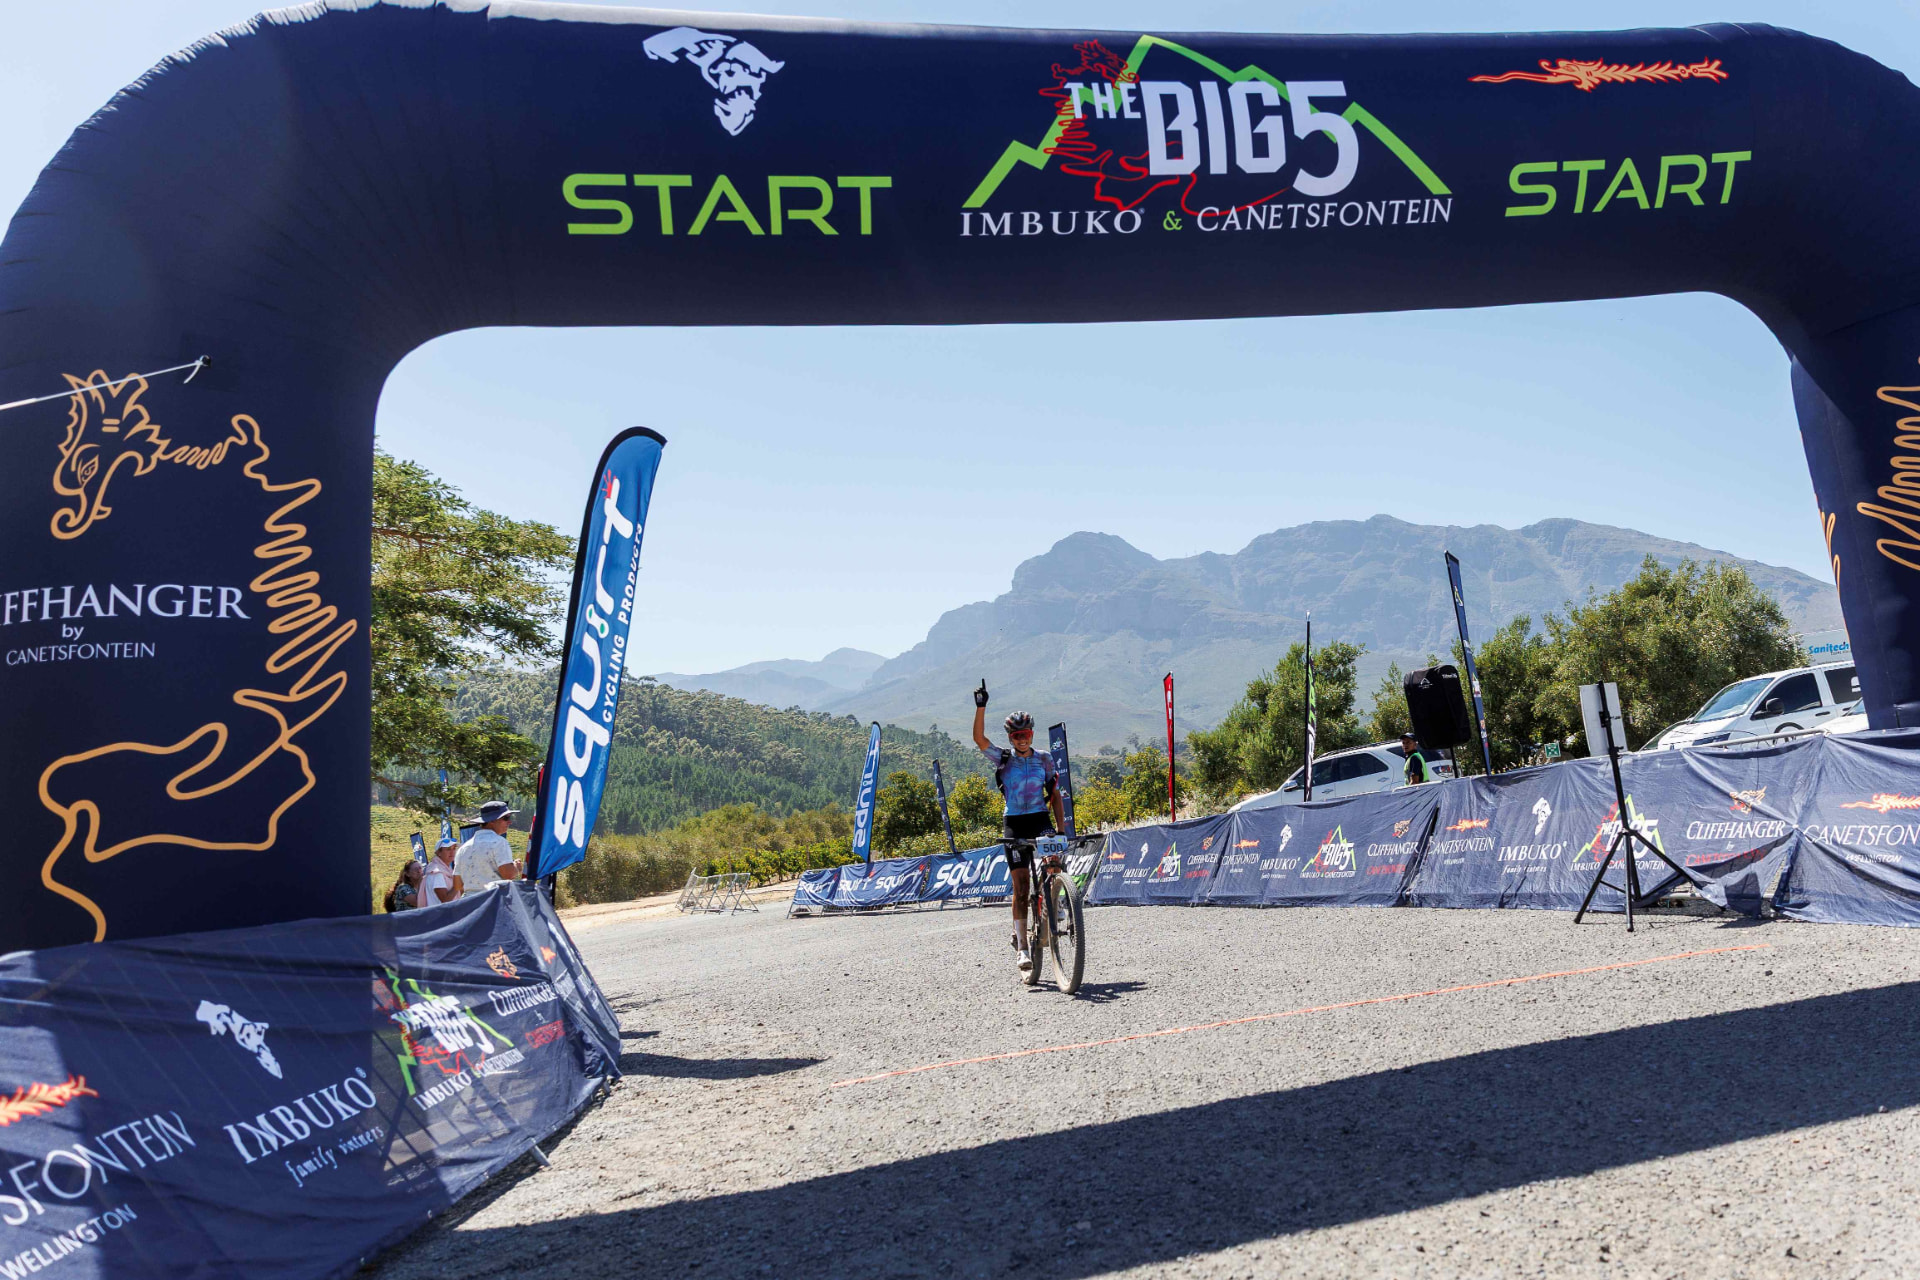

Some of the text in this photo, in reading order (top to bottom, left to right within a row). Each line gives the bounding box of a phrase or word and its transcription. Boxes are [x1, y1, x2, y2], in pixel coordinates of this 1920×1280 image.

[1064, 81, 1142, 119] THE
[1504, 150, 1752, 218] START
[562, 173, 893, 235] START
[1163, 209, 1183, 232] &
[1197, 197, 1453, 233] CANETSFONTEIN
[0, 584, 252, 627] FFHANGER
[62, 624, 84, 641] by
[1808, 641, 1850, 655] Sanitech
[6, 642, 156, 666] CANETSFONTEIN
[553, 477, 634, 849] squirt
[602, 633, 626, 723] CYCLING
[1043, 843, 1063, 853] 500
[1367, 842, 1419, 857] CLIFFHANGER
[1686, 820, 1786, 840] CLIFFHANGER
[413, 1071, 473, 1111] IMBUKO
[284, 1145, 338, 1188] family
[0, 1203, 138, 1280] WELLINGTON
